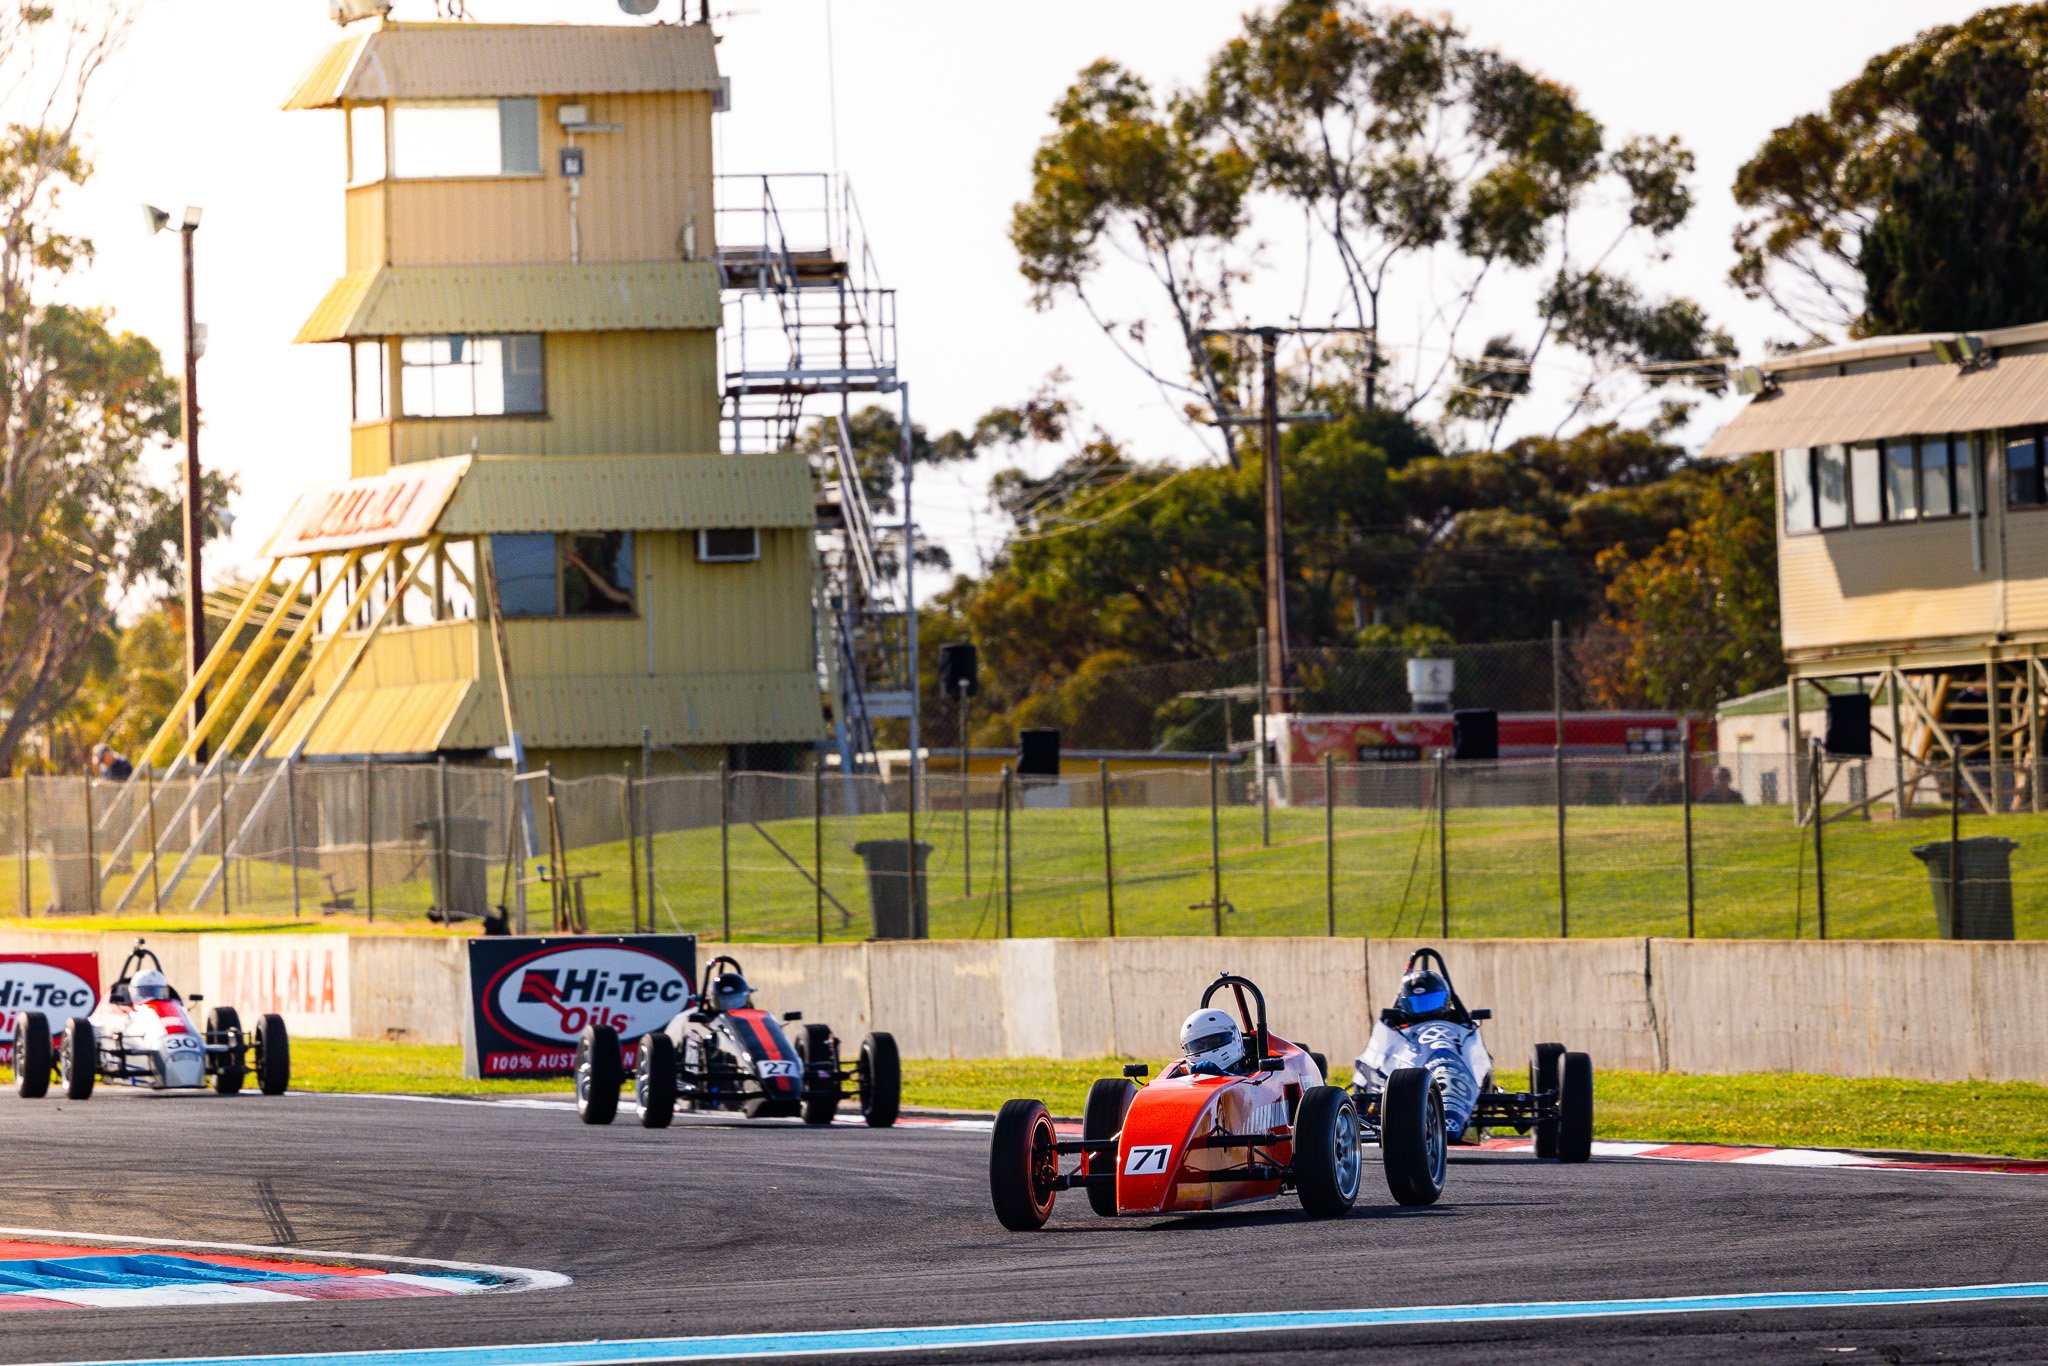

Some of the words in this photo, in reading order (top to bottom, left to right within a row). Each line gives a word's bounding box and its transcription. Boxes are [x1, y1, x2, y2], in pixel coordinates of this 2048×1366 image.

[220, 950, 335, 1013] MALLALA
[559, 969, 683, 1003] Hi-Tec
[560, 1007, 629, 1034] Oils
[166, 1038, 197, 1049] 30
[492, 1055, 532, 1070] 100%
[764, 1062, 793, 1075] 27
[1132, 1148, 1168, 1171] 71
